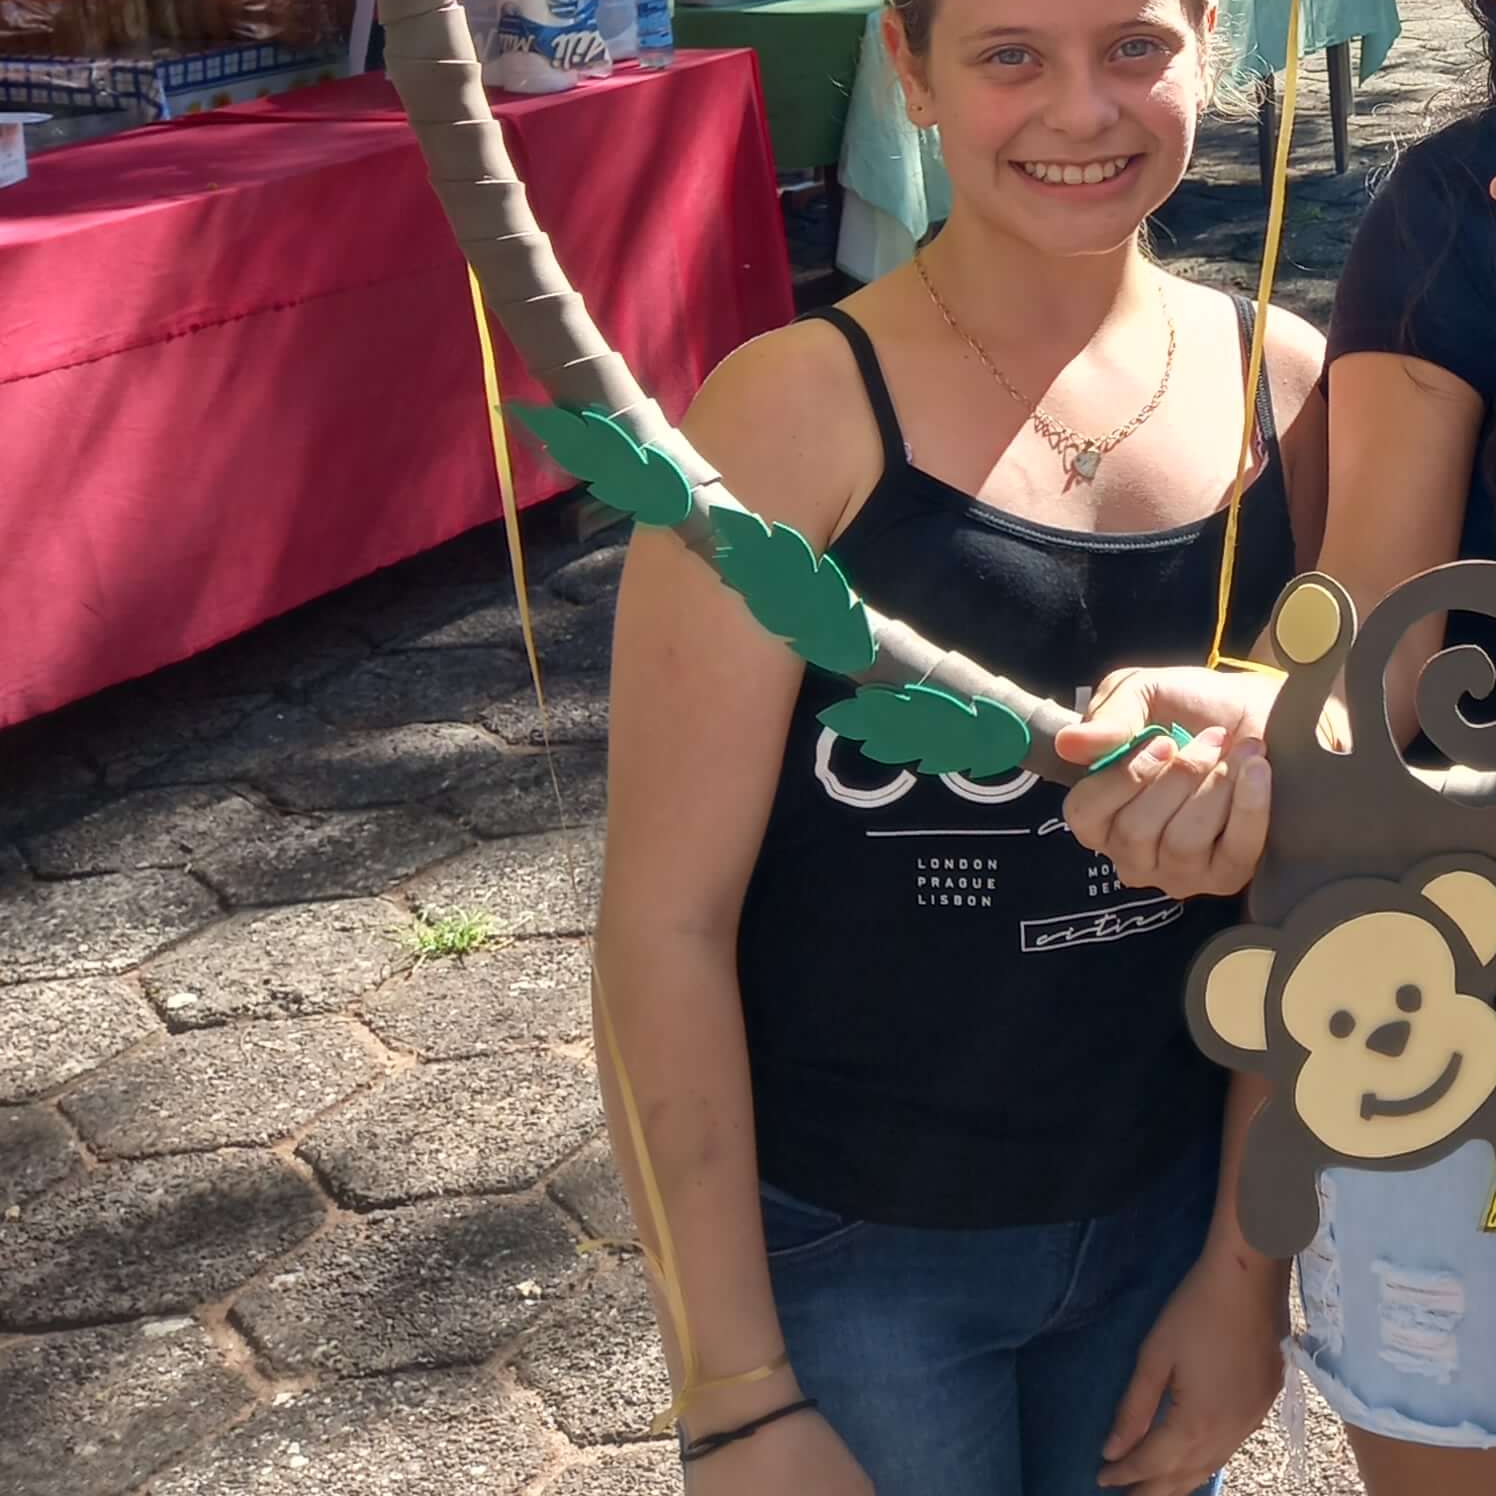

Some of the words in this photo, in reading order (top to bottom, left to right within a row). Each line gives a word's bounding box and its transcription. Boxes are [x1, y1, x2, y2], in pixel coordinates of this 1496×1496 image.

[917, 857, 998, 871] LONDON
[917, 876, 996, 890] PRAGUE
[917, 893, 992, 907] LISBON
